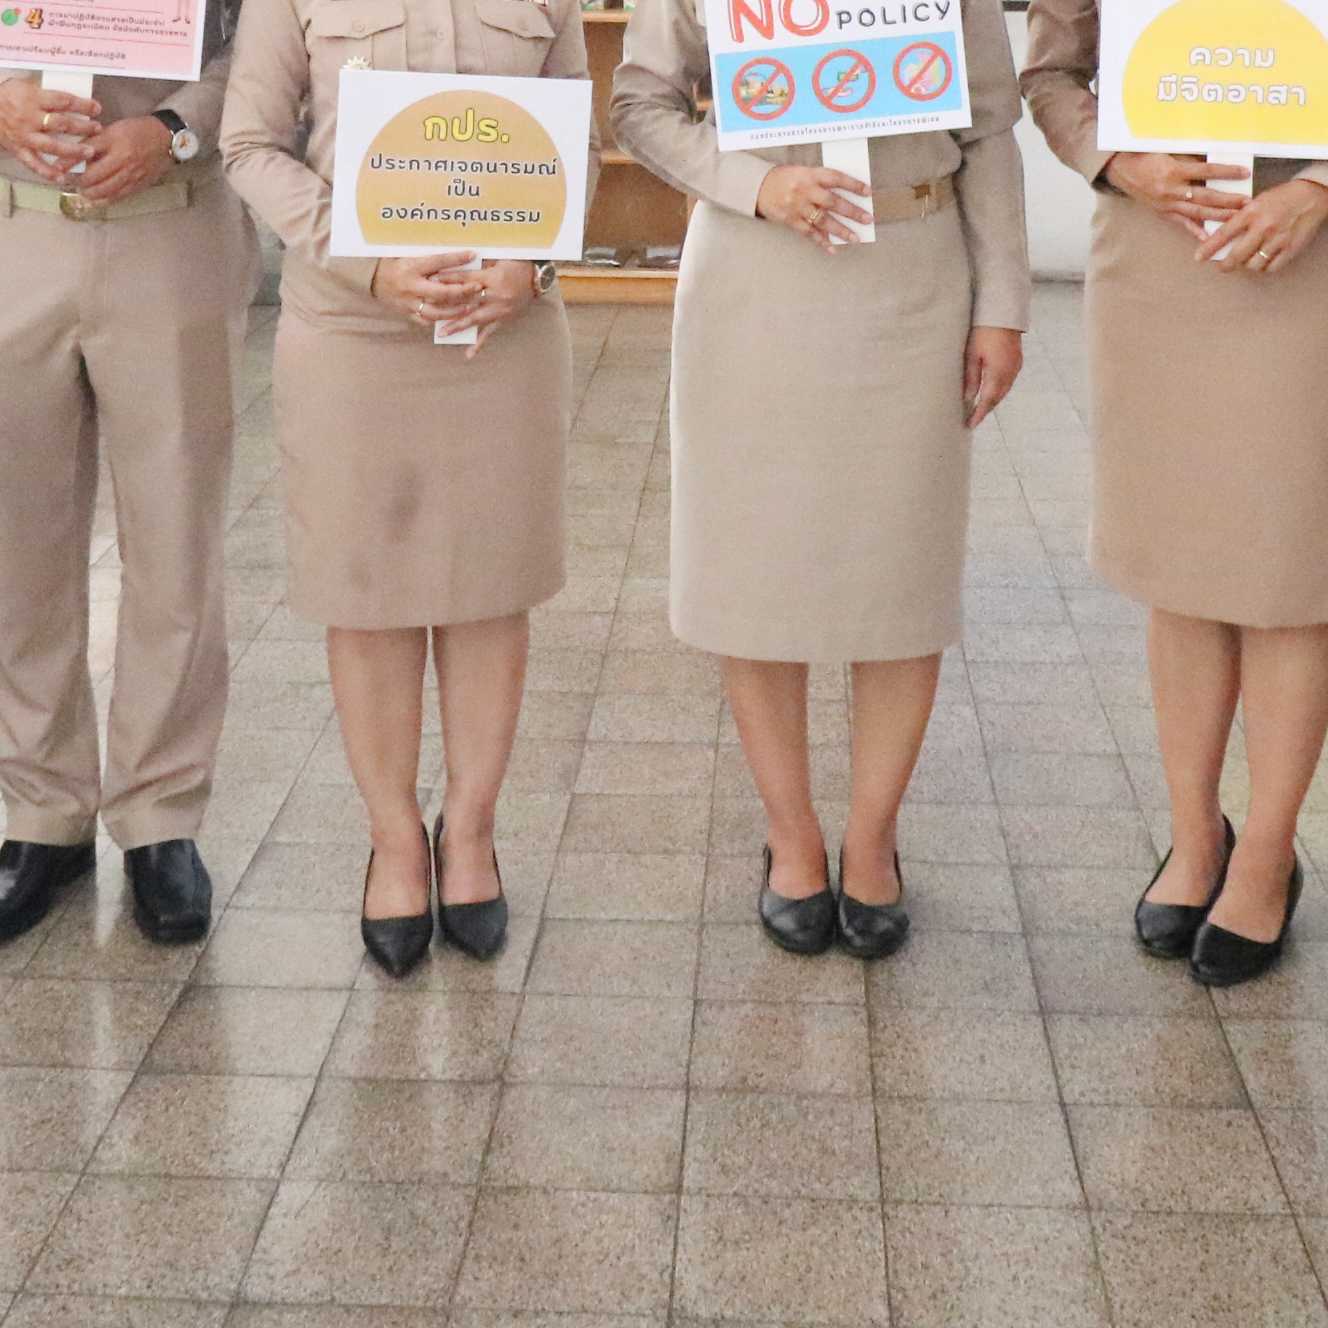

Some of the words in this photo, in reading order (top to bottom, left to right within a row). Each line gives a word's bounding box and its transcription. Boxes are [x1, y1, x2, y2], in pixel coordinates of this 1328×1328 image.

[25, 8, 45, 30] 4
[835, 0, 951, 31] POLICY
[1188, 45, 1276, 69] ความ
[1156, 73, 1307, 107] มีจิตอาสา
[423, 107, 511, 145] กปร.
[370, 153, 558, 176] ประกาศเจตนารมณ์
[446, 178, 482, 198] เป็น
[380, 202, 542, 228] องค์กรคุณธรรม
